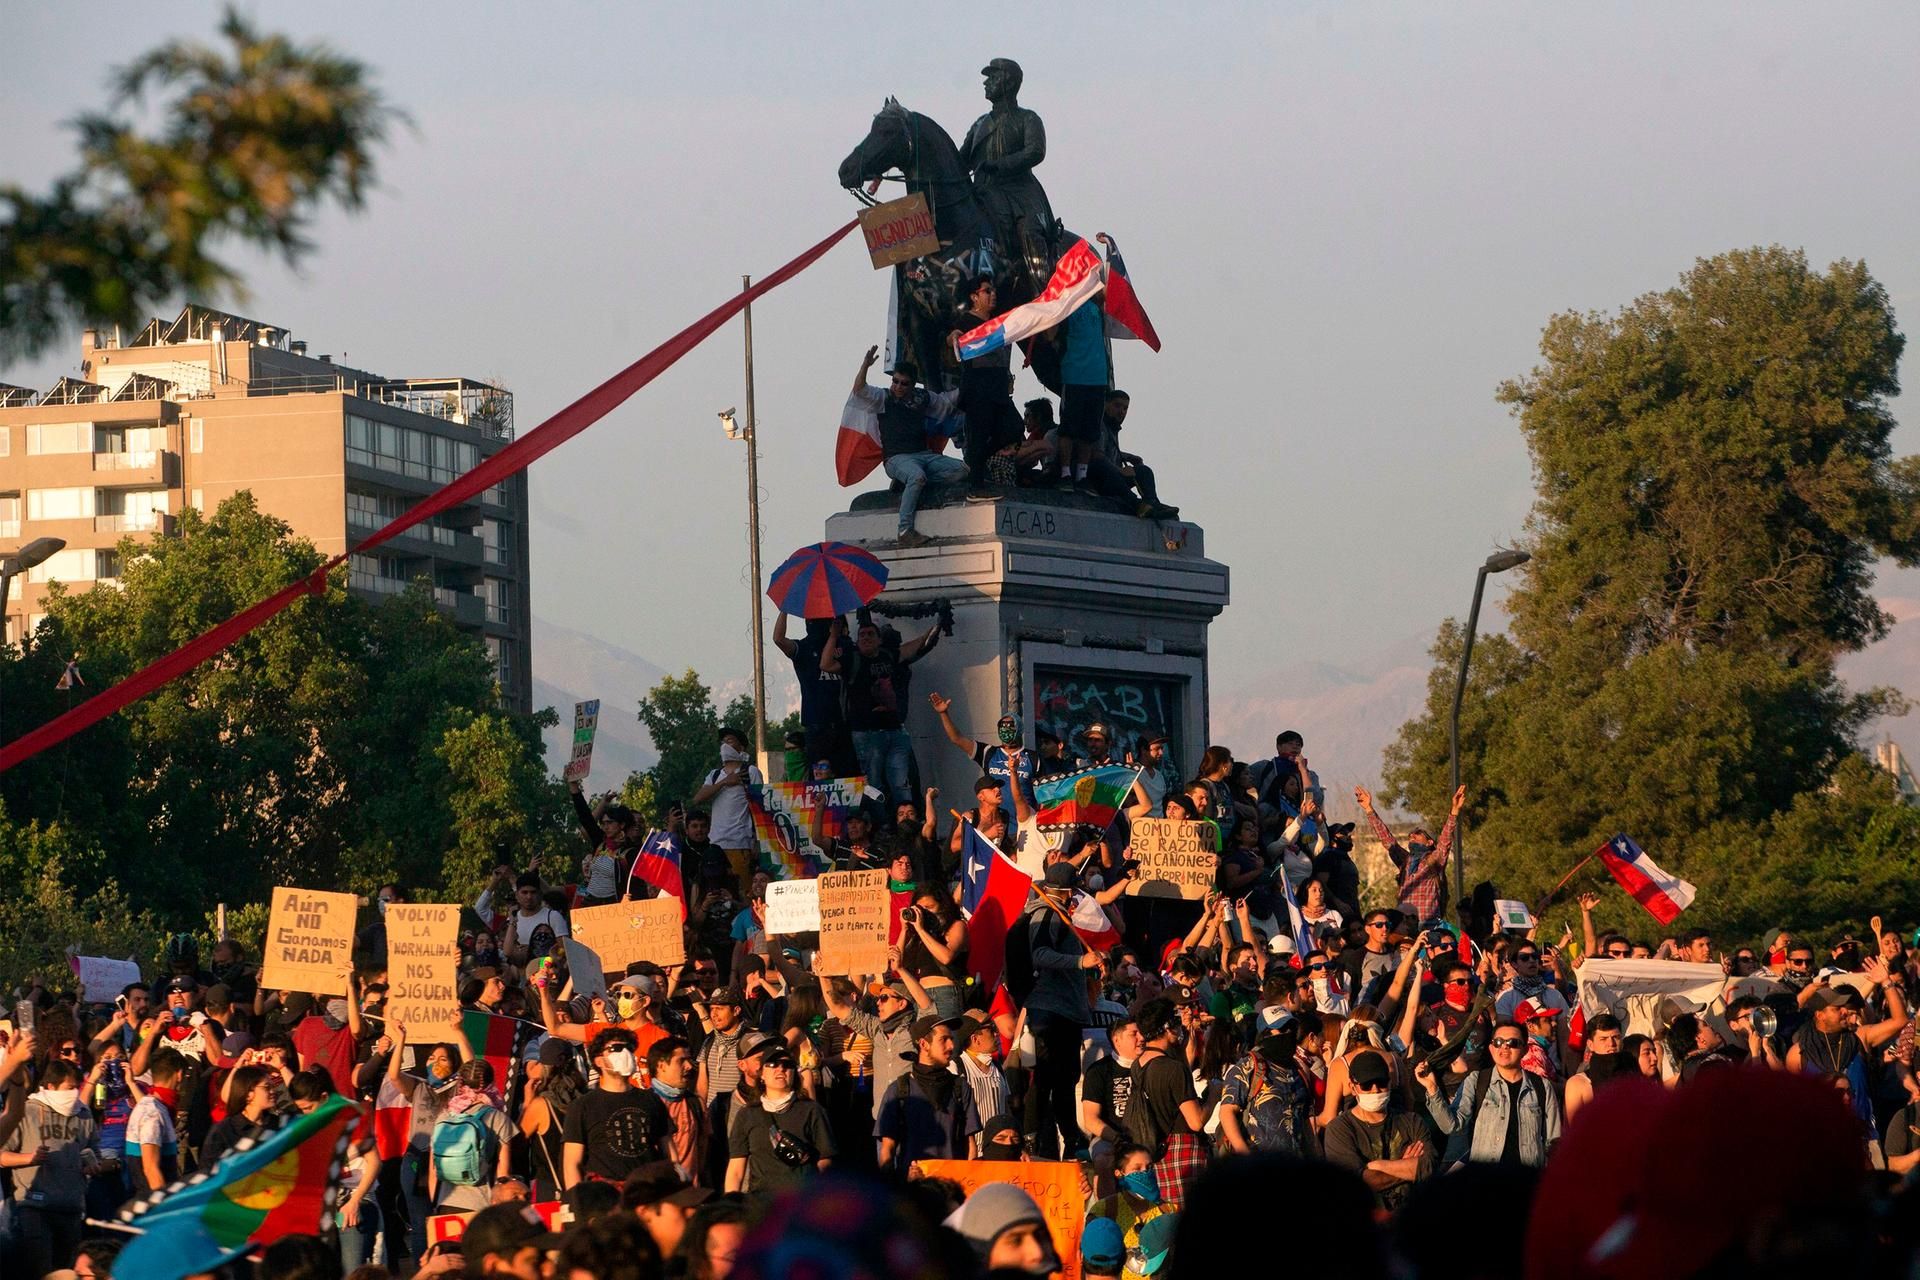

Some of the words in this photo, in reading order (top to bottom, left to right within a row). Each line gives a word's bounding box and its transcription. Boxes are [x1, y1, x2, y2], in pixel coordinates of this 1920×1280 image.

[1132, 820, 1171, 837] COMO
[1158, 837, 1216, 854] RAZONA
[822, 872, 871, 889] AGUANTE
[283, 894, 329, 914] Aún
[296, 913, 322, 930] NO
[396, 907, 447, 922] VOLVIÓ
[821, 907, 845, 919] VENGA
[848, 907, 857, 915] EL
[412, 926, 431, 937] LA
[822, 923, 832, 932] SE
[835, 922, 844, 931] LO
[847, 921, 874, 931] PLANTE
[277, 927, 348, 949] Ganamos
[282, 947, 334, 965] NADA
[406, 964, 433, 979] NOS
[394, 982, 452, 1000] SIGUEN
